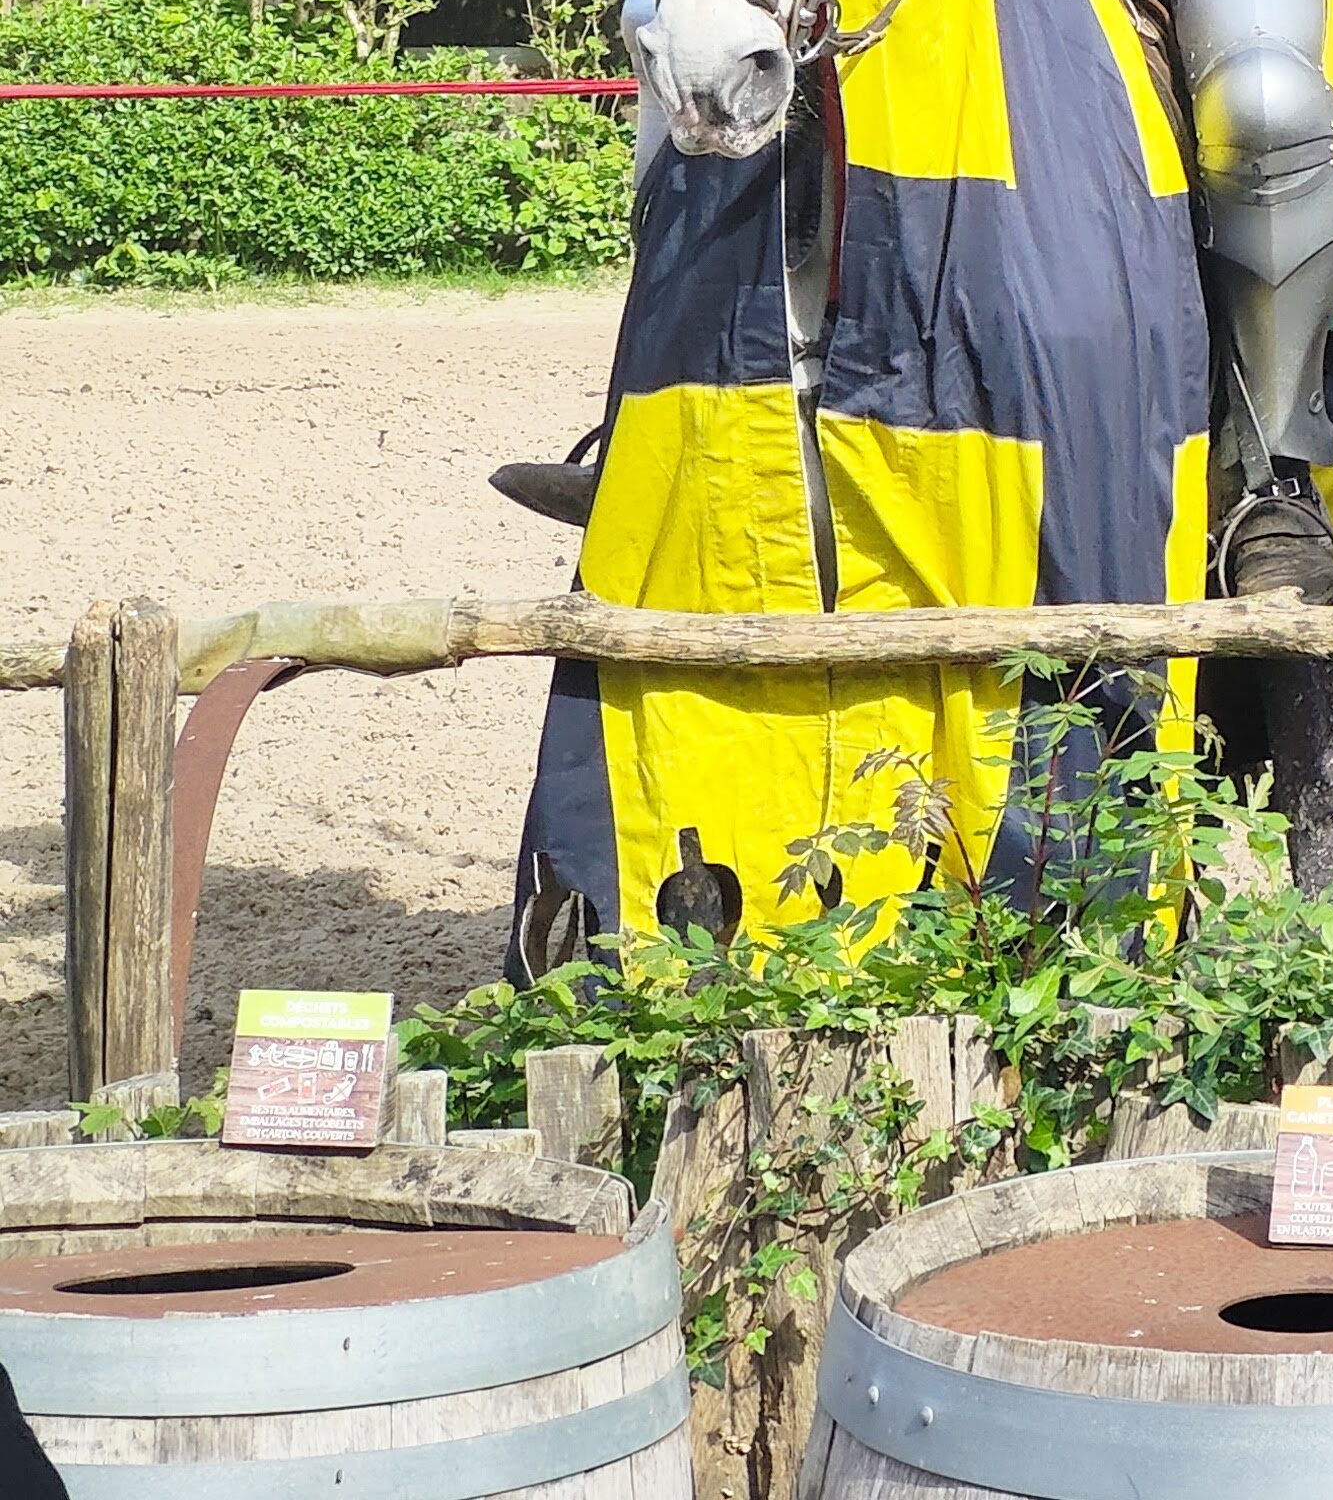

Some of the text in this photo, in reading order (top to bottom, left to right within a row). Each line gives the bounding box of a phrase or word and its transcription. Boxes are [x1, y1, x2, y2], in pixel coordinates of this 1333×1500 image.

[251, 1105, 287, 1115] RESTES
[240, 1116, 301, 1127] EMBALLAGES
[314, 1119, 364, 1129] GOBELETS
[246, 1128, 260, 1138] EN
[302, 1130, 355, 1141] COUVERTS
[1277, 1225, 1291, 1235] EN
